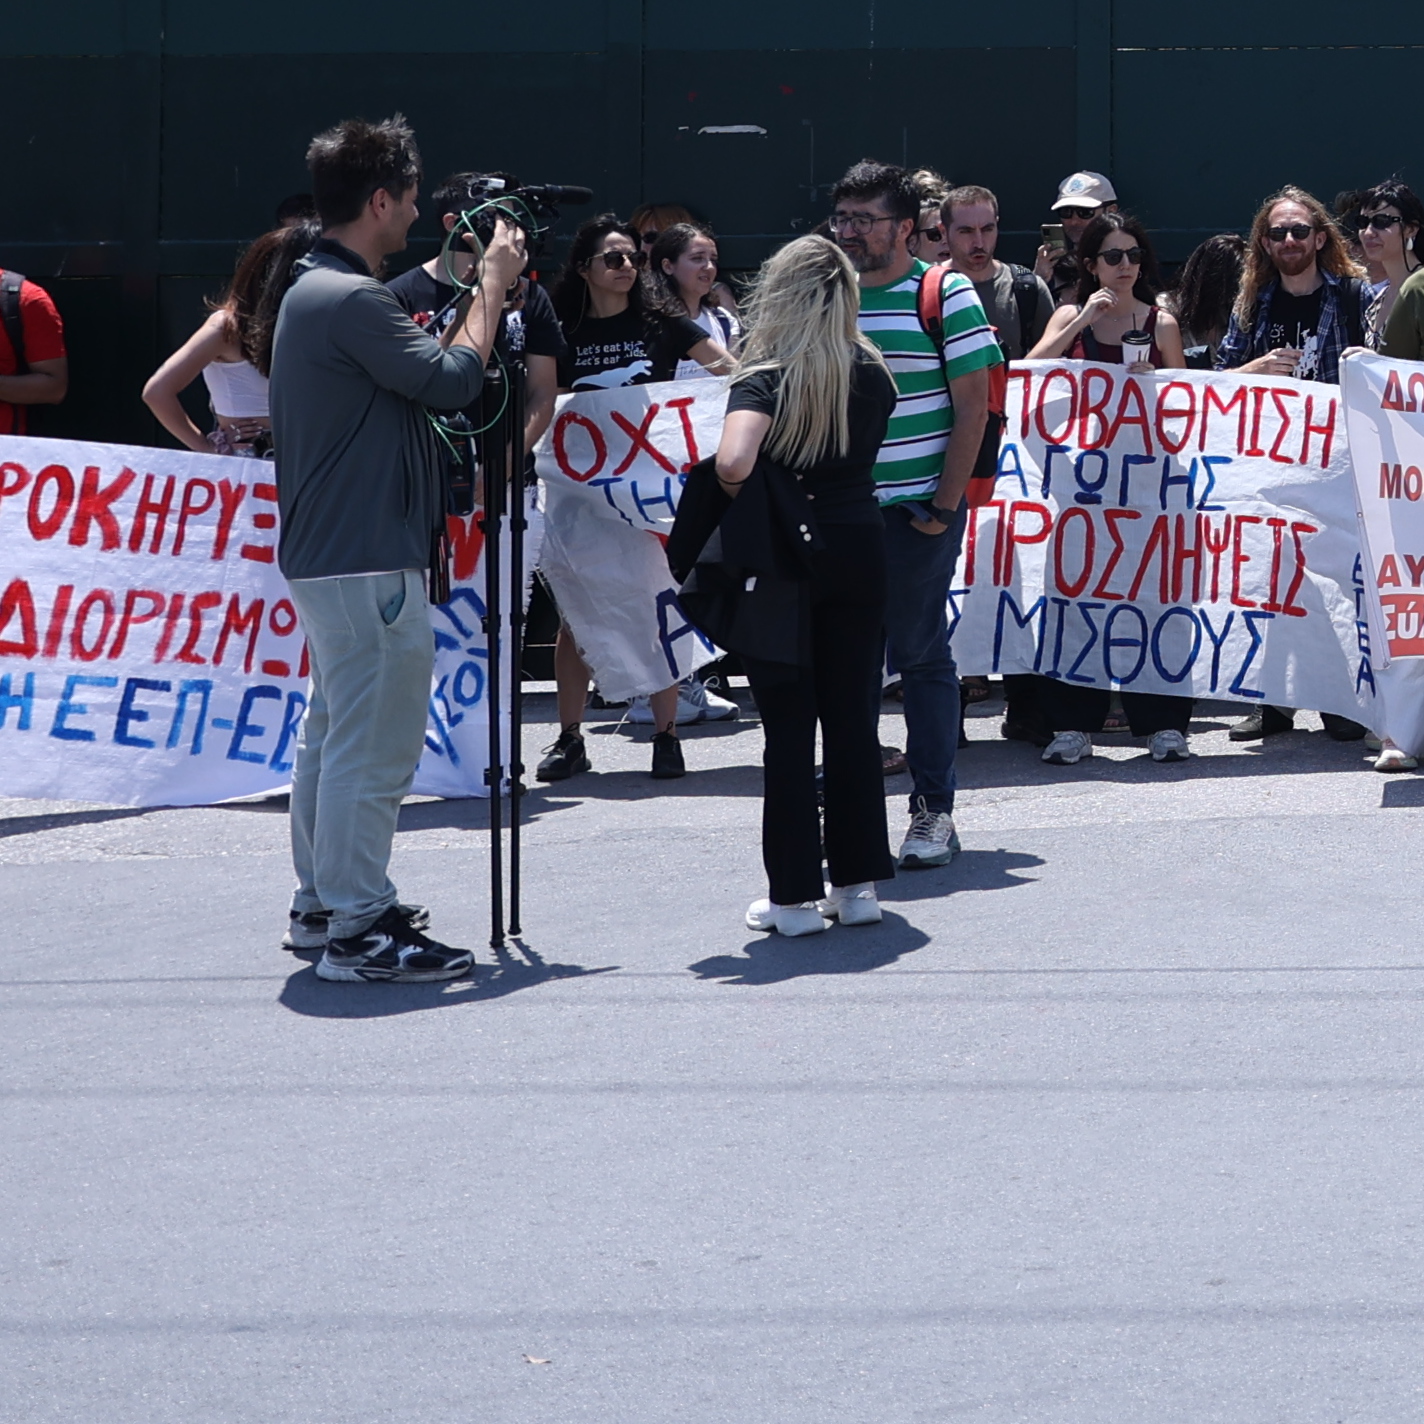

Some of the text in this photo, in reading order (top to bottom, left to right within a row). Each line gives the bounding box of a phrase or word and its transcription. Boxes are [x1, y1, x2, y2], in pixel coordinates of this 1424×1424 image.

[603, 342, 621, 353] eat
[603, 355, 620, 364] eat
[553, 397, 700, 482] ΟΧΙ
[964, 500, 1318, 617] ΠΡΟΣΛΗΨΕΙΣ
[992, 590, 1276, 699] ΜΙΣΘΟΥΣ
